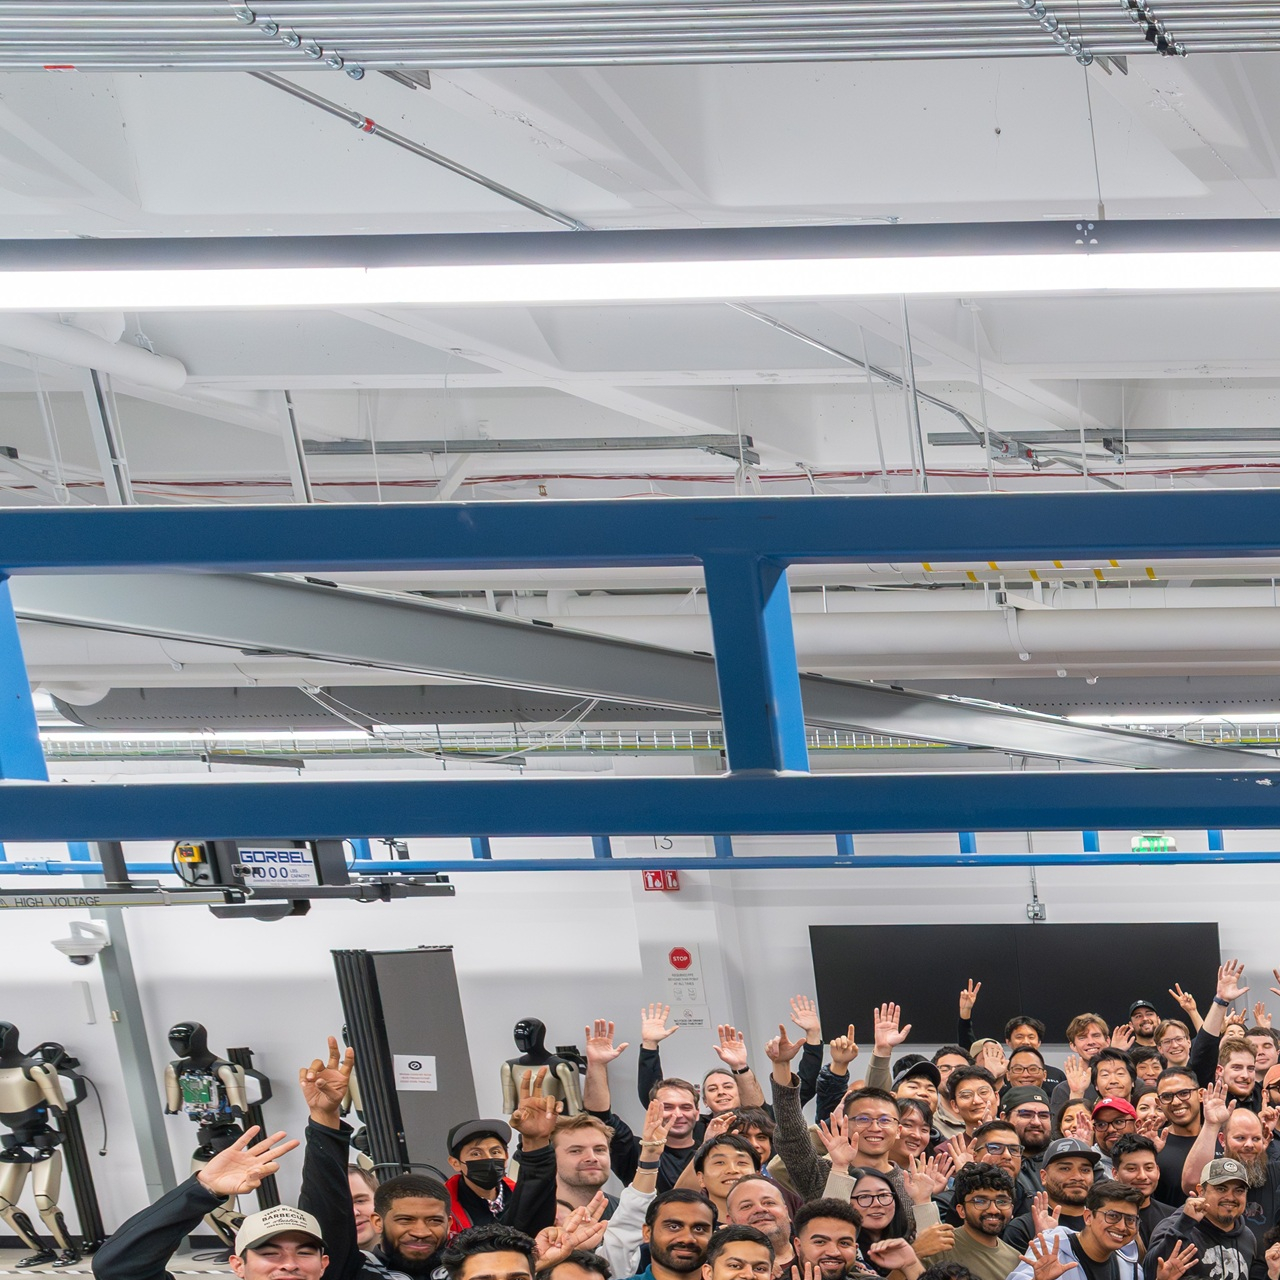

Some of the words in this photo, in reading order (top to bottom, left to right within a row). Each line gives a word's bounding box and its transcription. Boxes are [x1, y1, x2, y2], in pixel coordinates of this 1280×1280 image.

[240, 851, 313, 863] GORBEL
[252, 867, 288, 879] 000
[14, 896, 45, 908] HIGH
[49, 895, 101, 907] VOLTAGE
[262, 1213, 308, 1222] BARBECUE
